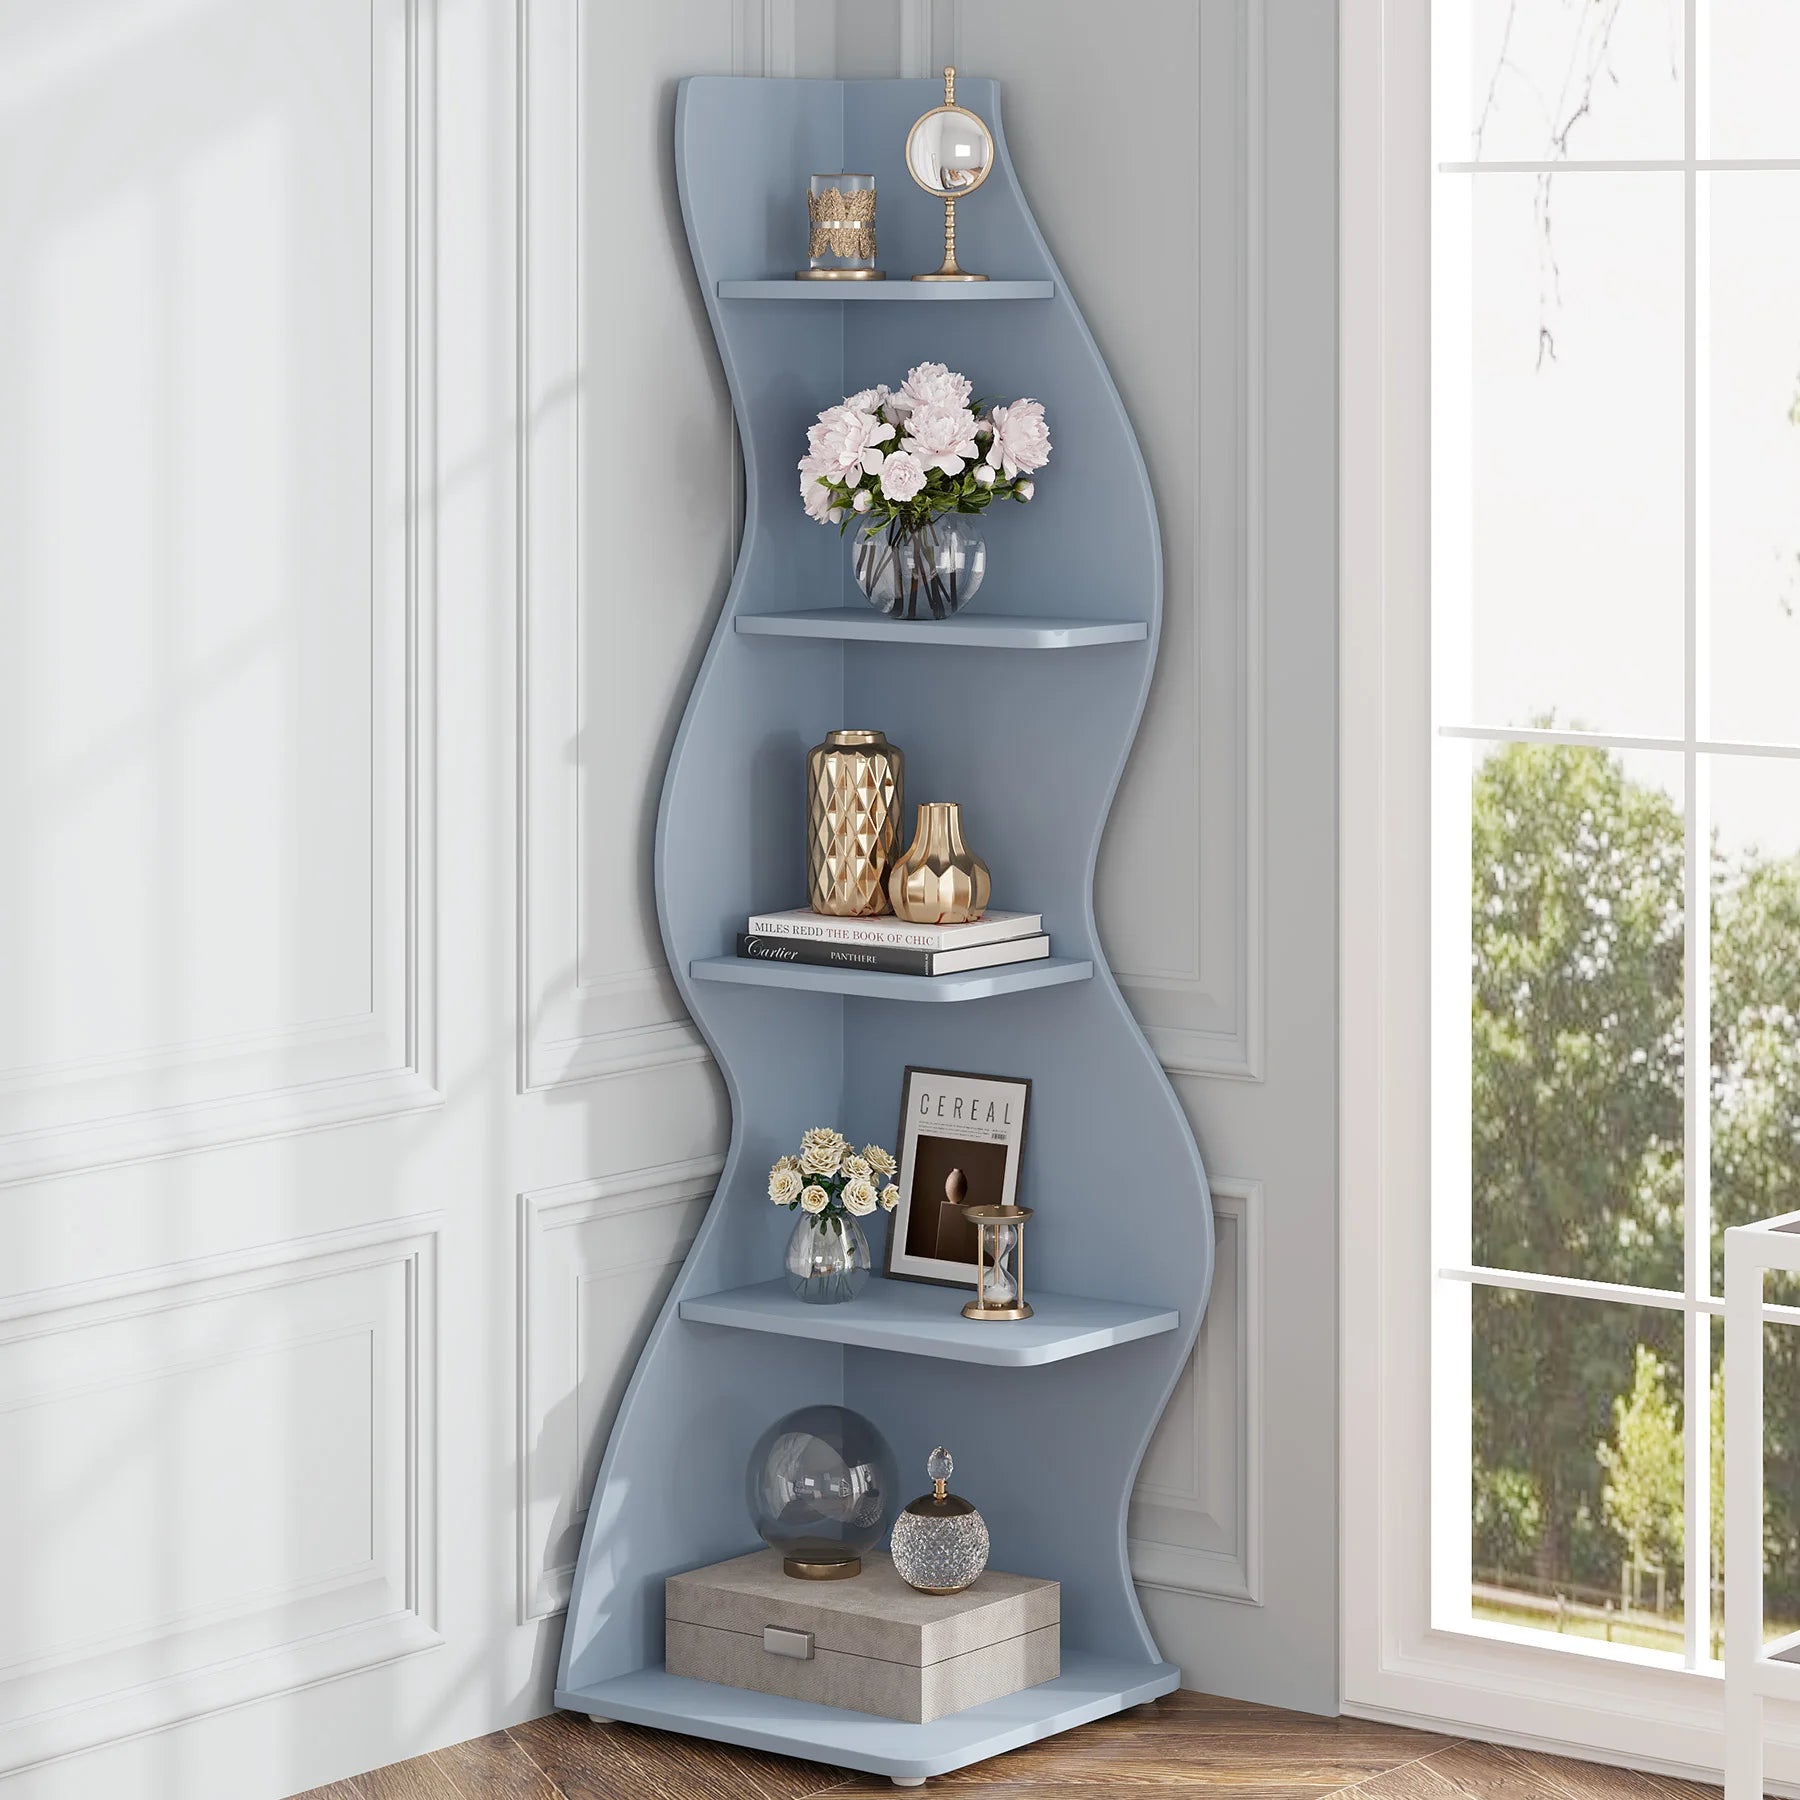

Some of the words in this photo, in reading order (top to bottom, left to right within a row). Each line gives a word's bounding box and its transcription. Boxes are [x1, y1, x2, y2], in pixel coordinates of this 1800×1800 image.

[755, 922, 789, 934] MILES
[792, 925, 823, 937] REDD
[826, 928, 850, 939] THE
[853, 930, 884, 943] BOOK
[887, 934, 903, 944] OF
[905, 935, 934, 946] CHIC
[744, 935, 799, 960] Cartier
[830, 951, 878, 964] PANTHERE
[920, 1093, 1012, 1125] CEREAL
